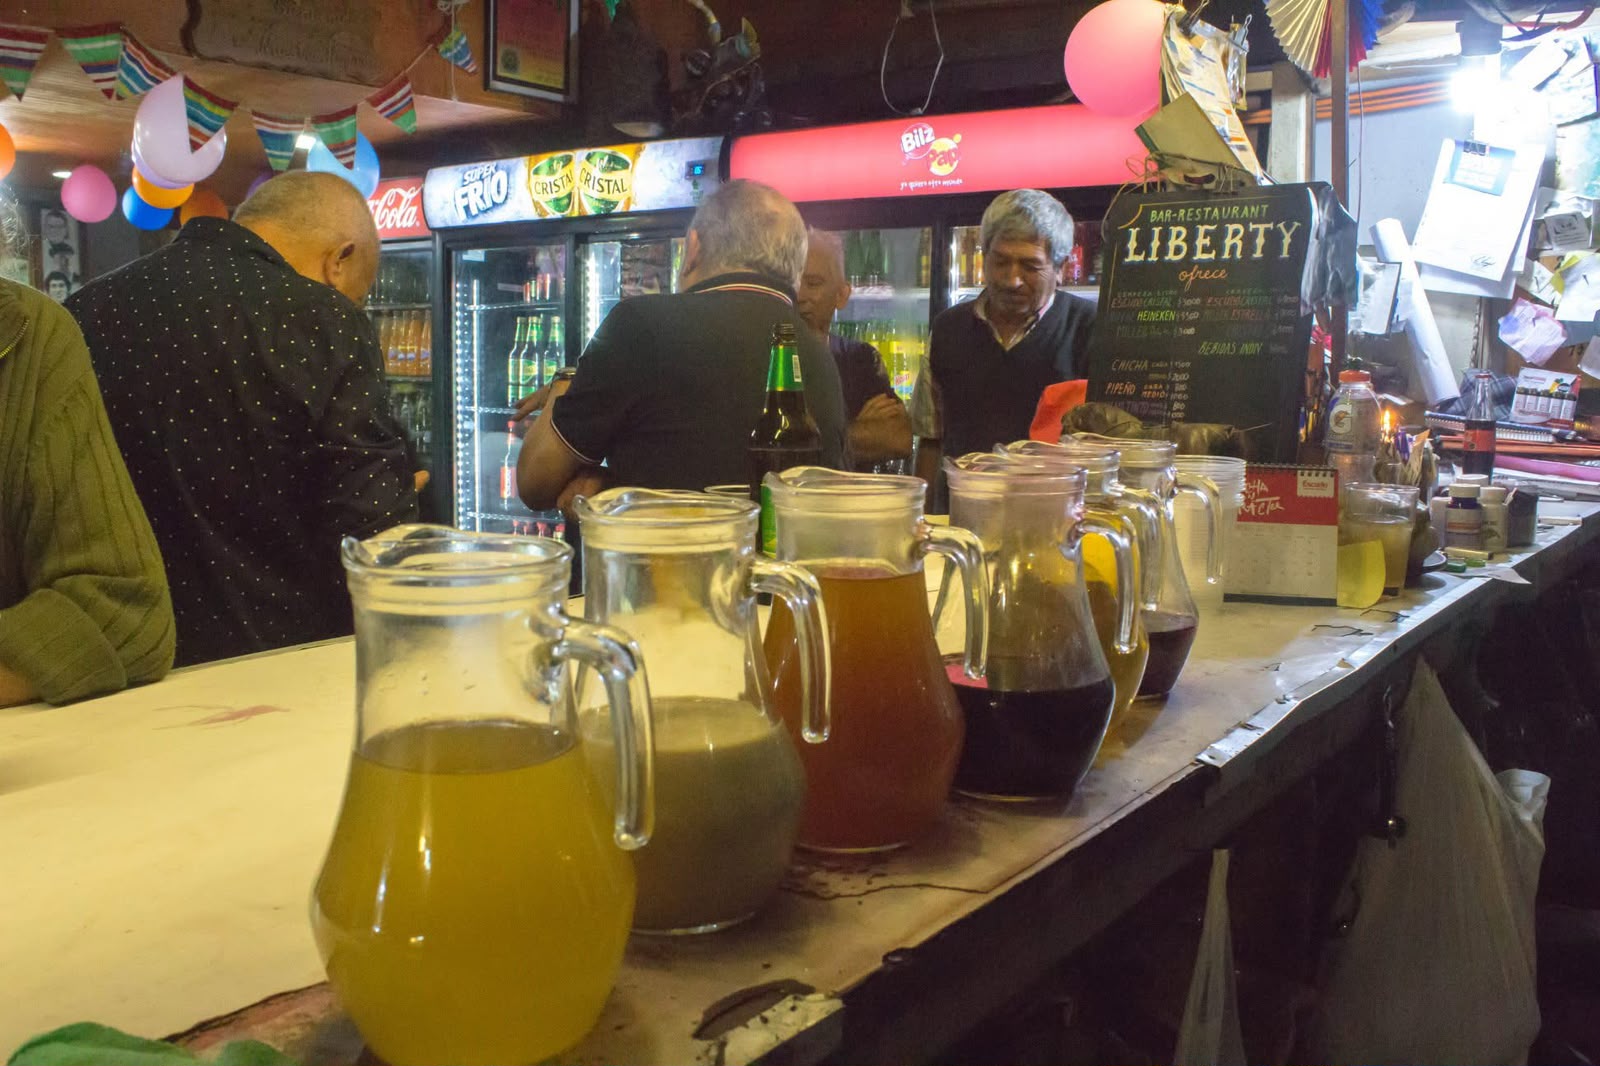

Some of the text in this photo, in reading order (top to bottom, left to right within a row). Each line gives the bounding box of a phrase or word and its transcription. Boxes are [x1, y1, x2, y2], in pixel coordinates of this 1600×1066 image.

[901, 128, 936, 153] Bilz
[463, 162, 498, 185] SUPER
[579, 168, 628, 195] CRISTAL
[1149, 204, 1270, 223] BAR-RESTAURANT
[1123, 221, 1302, 263] LIBERTY
[1178, 264, 1229, 290] ofrece
[1136, 310, 1176, 322] HEINEKEN
[1111, 358, 1149, 372] CHICHA
[1105, 380, 1136, 396] PIPEÑO
